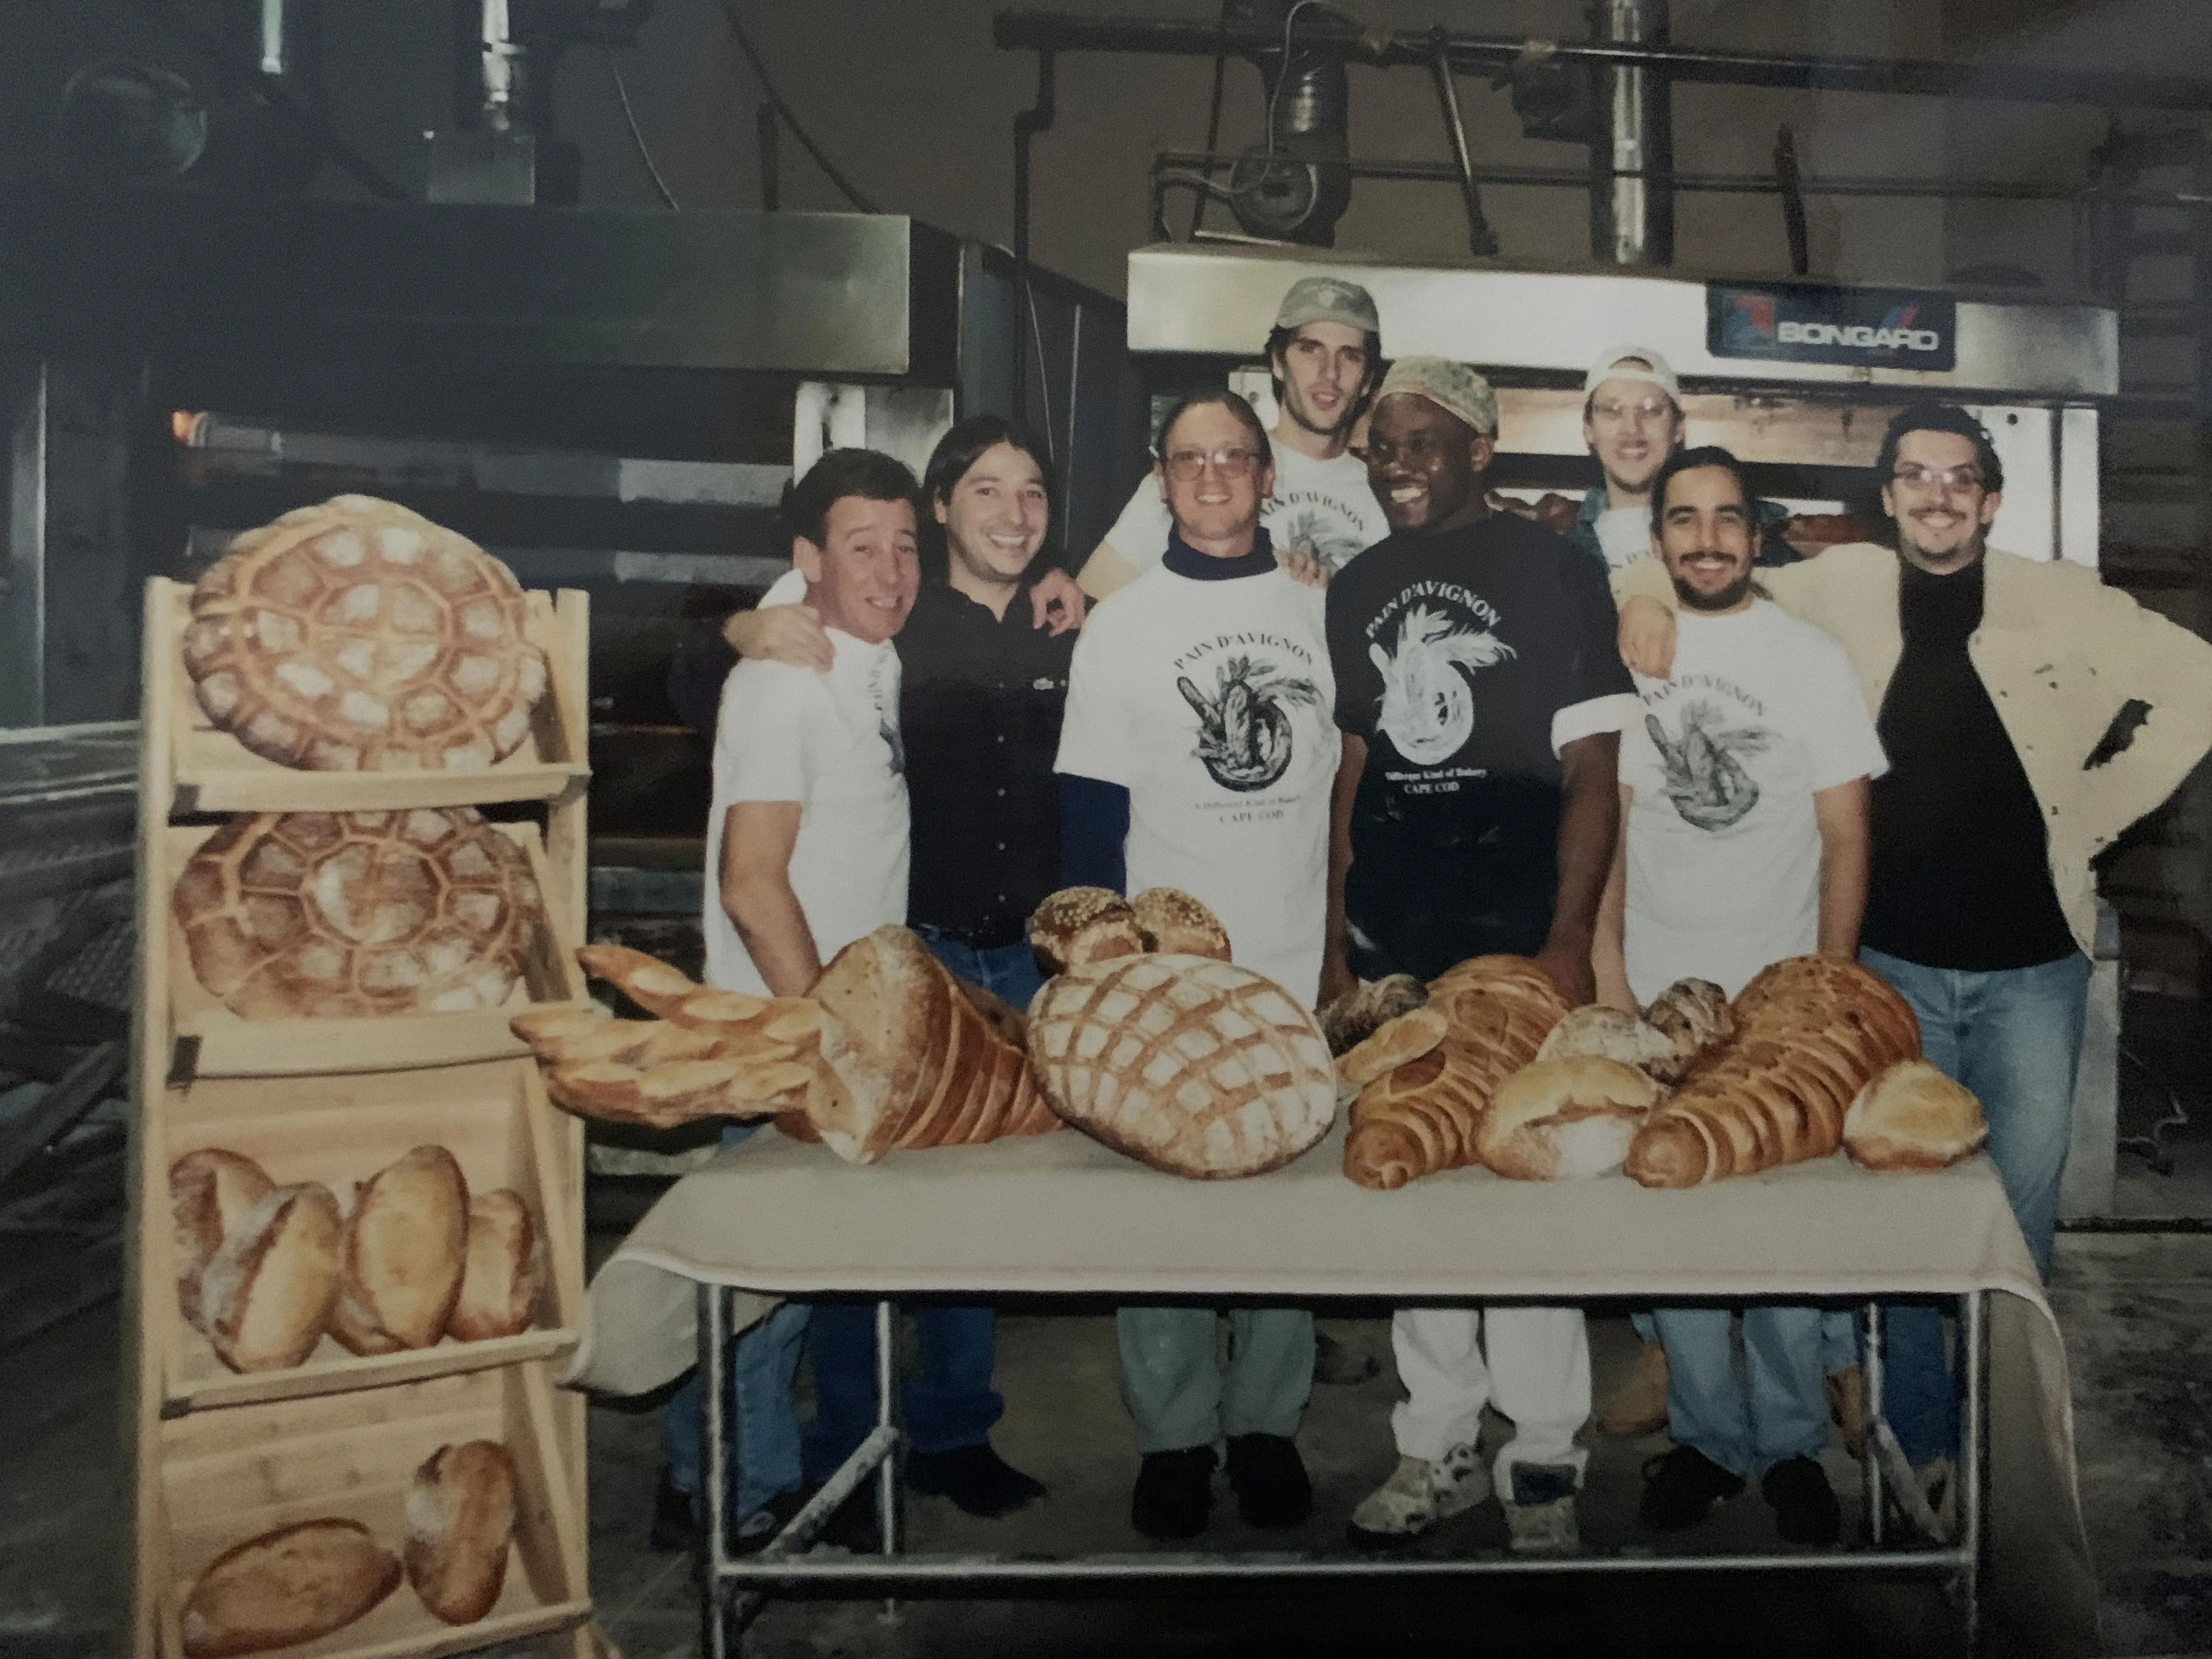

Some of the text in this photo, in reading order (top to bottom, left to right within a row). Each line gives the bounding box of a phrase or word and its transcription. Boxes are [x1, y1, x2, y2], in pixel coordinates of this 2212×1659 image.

[1777, 321, 1938, 351] BONGARD
[1259, 497, 1284, 516] AIN
[1401, 580, 1501, 627] D'AVIGNON
[1174, 632, 1313, 670] PAIN D'AVIGNON
[1403, 781, 1460, 794] CAPE COD
[1219, 809, 1285, 823] CAPE COD
